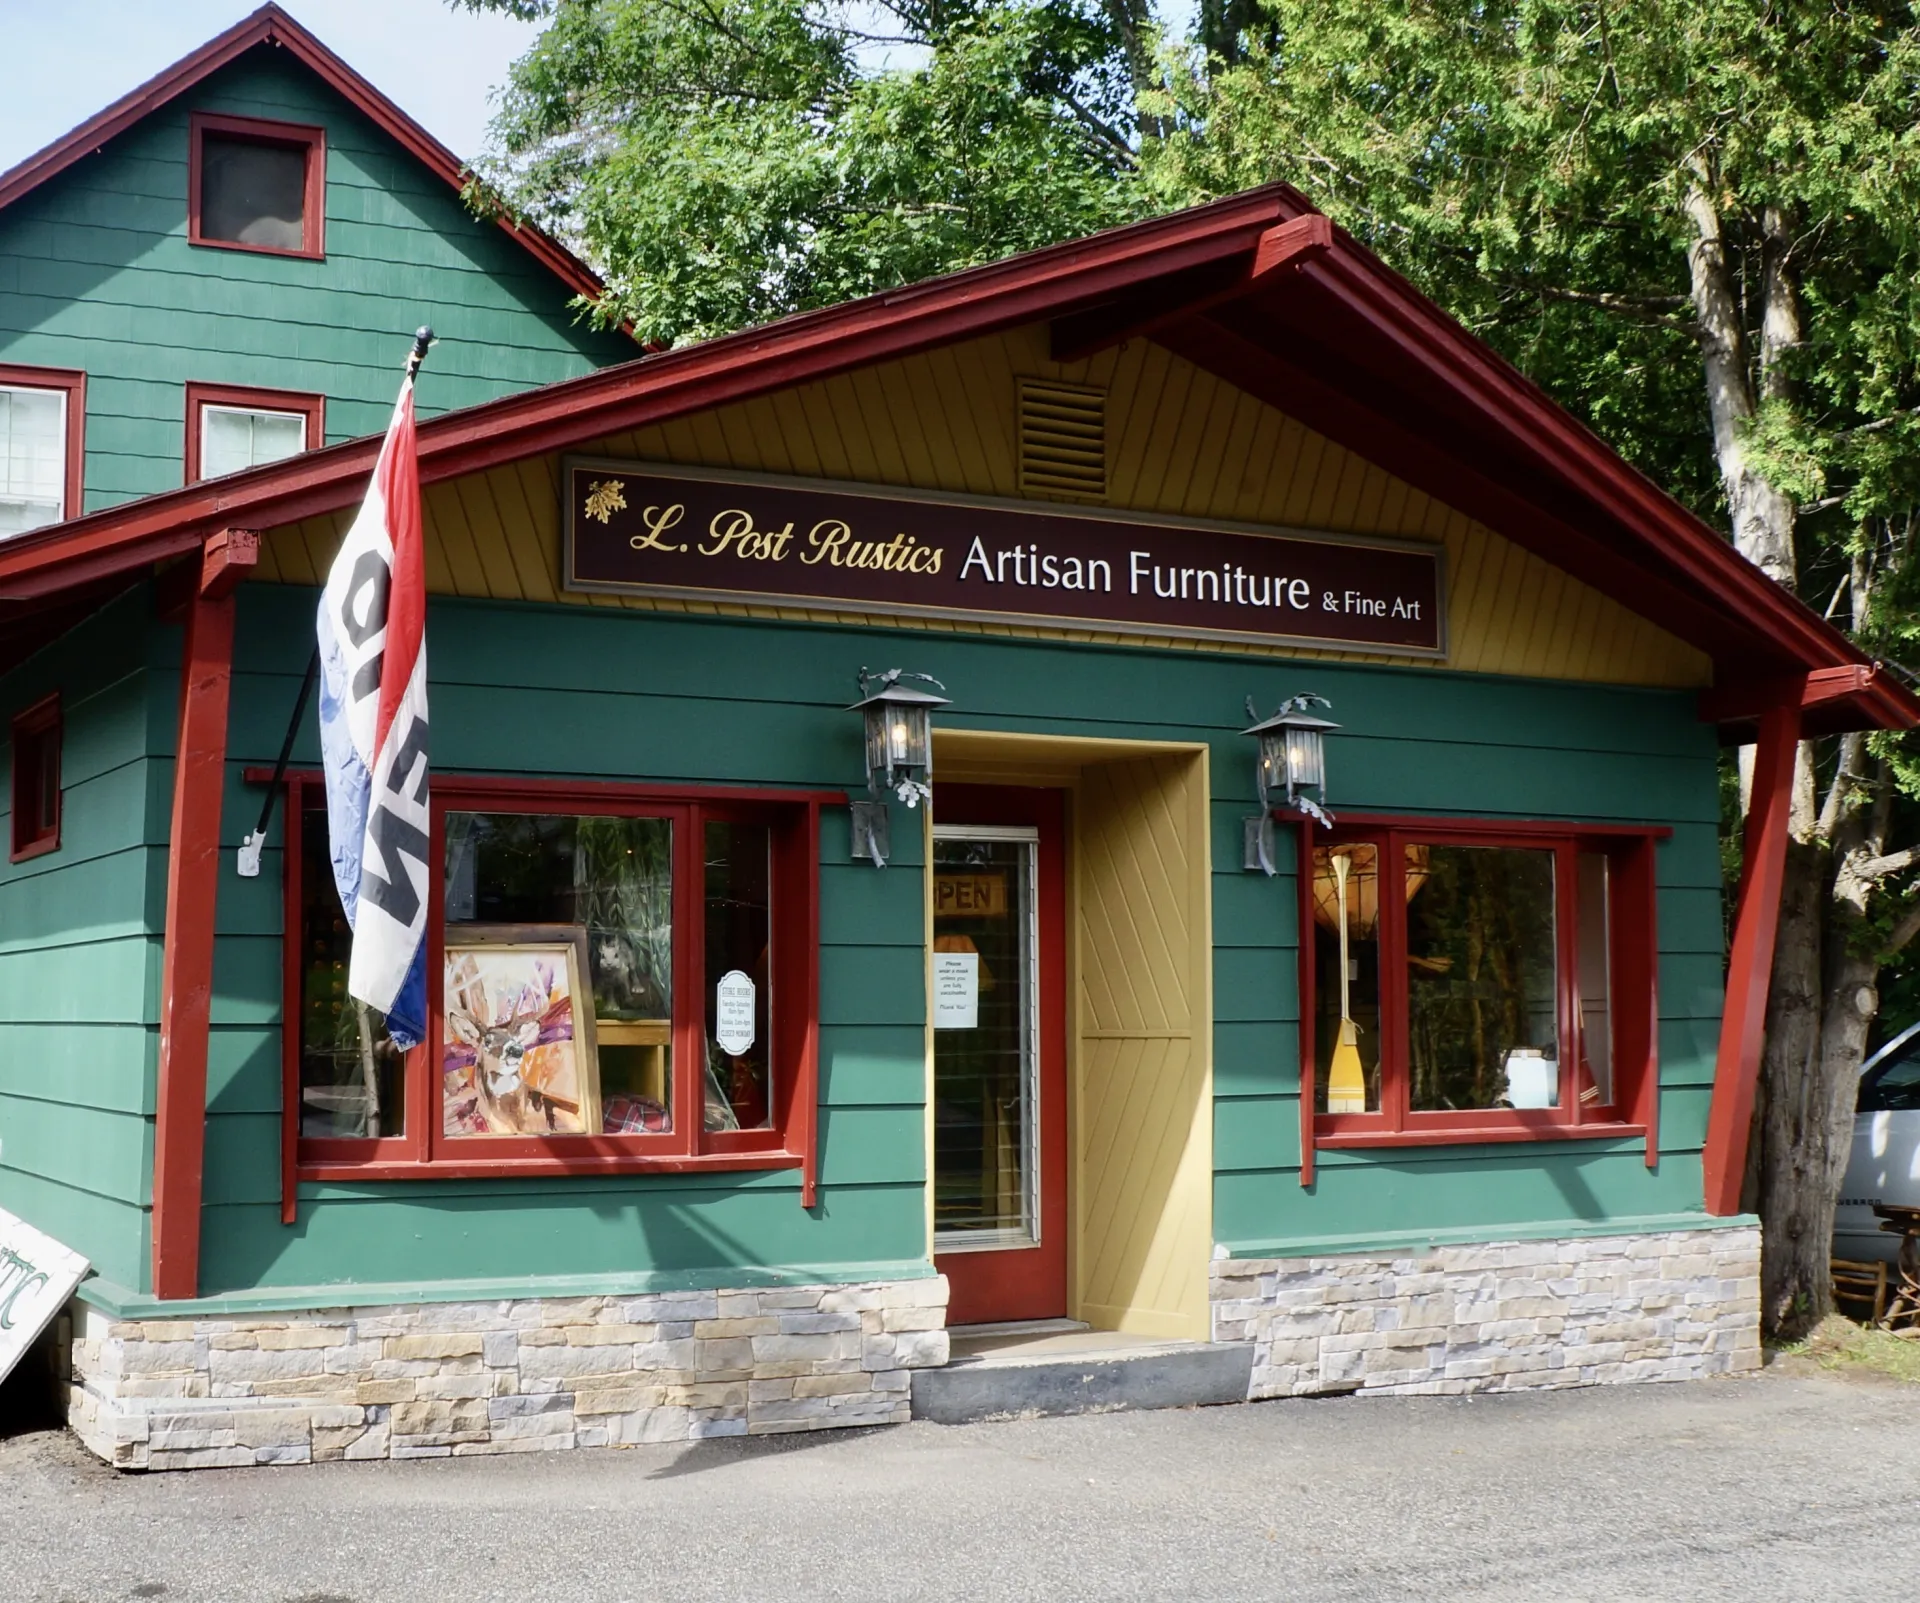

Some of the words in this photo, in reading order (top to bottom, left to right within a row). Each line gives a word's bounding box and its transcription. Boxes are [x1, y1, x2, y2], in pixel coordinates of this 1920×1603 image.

[630, 504, 687, 553] L.
[698, 509, 794, 560] Post
[800, 519, 943, 575] Rustics
[959, 535, 1112, 592] Artisan
[1130, 551, 1310, 609] Furniture
[1322, 591, 1339, 613] &
[1345, 591, 1387, 617] Fine
[1391, 596, 1421, 621] Art
[933, 880, 991, 910] PEN
